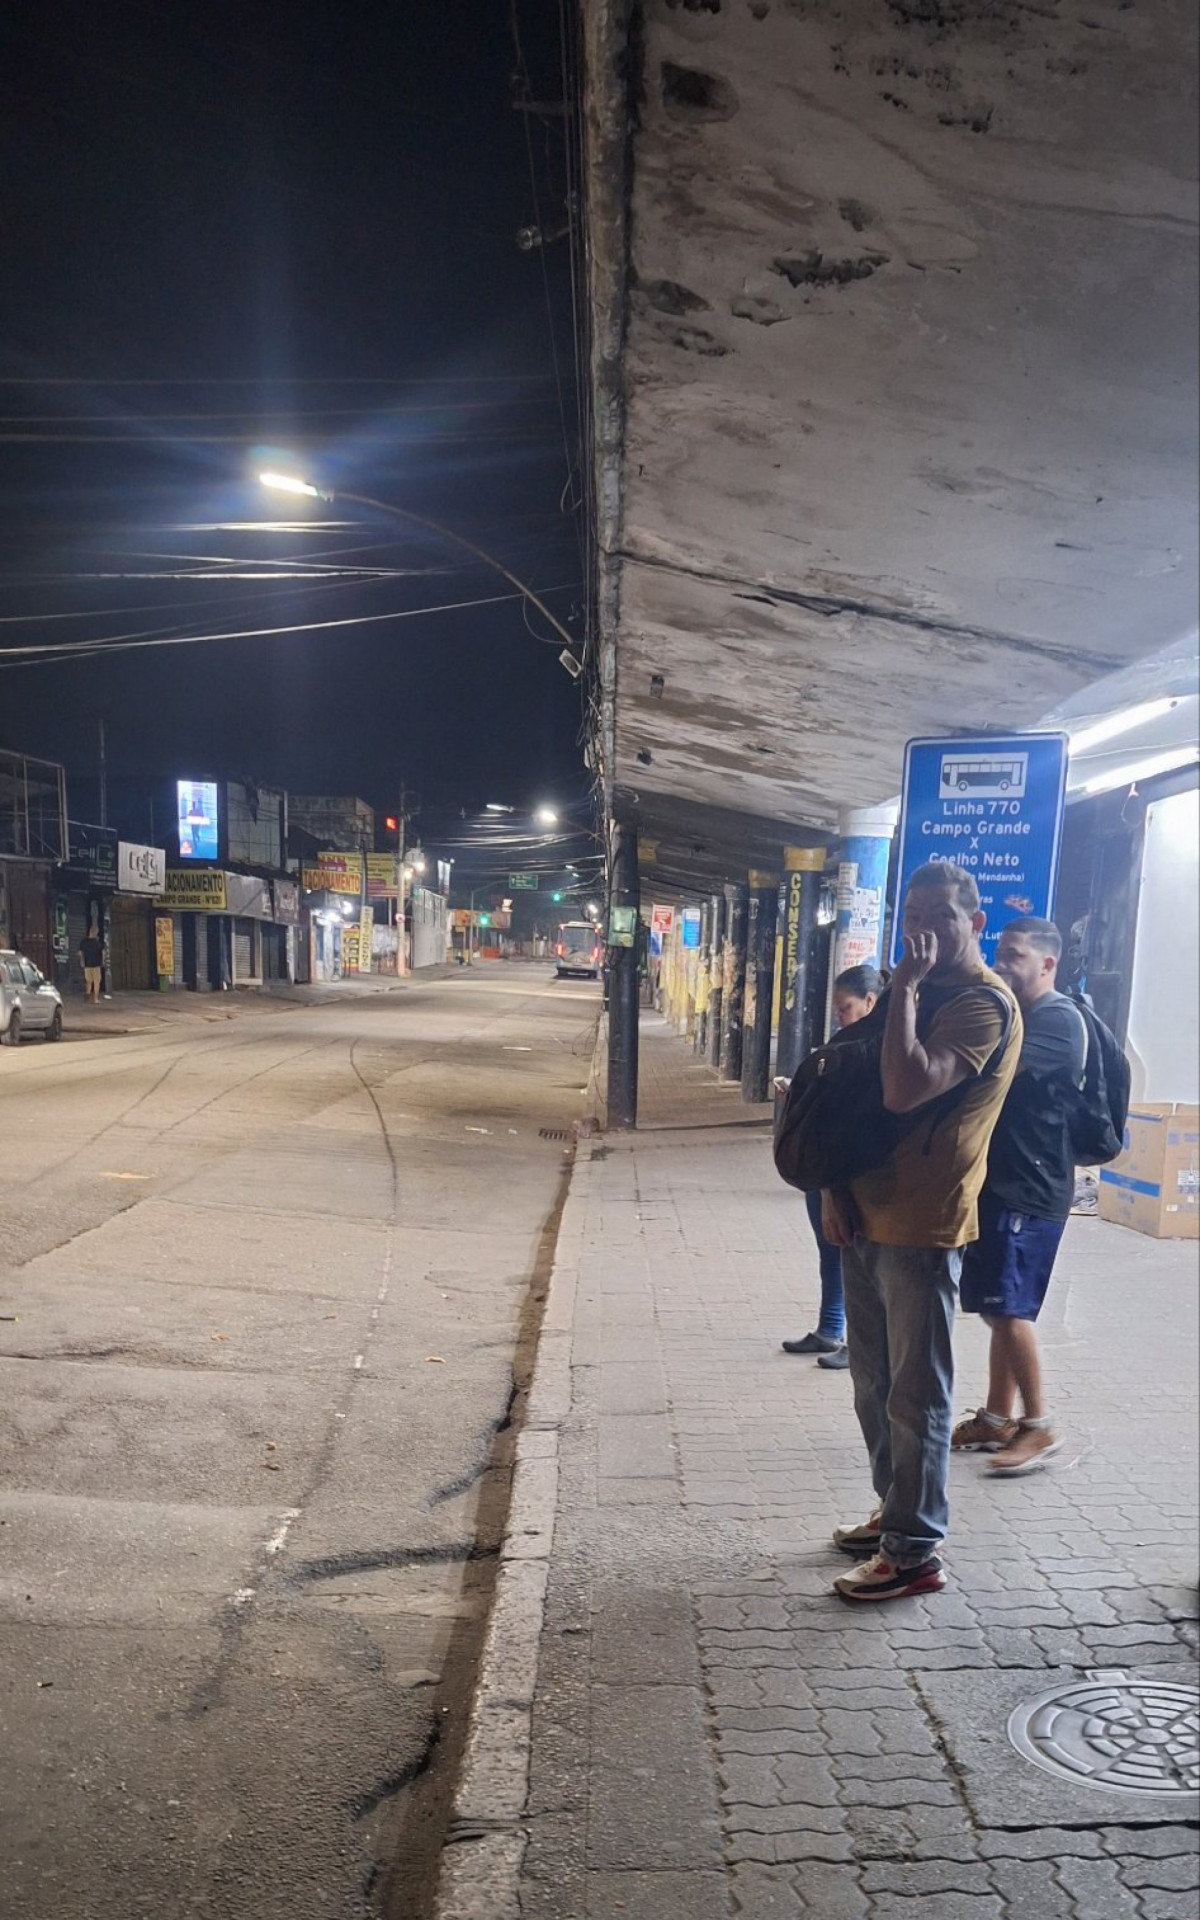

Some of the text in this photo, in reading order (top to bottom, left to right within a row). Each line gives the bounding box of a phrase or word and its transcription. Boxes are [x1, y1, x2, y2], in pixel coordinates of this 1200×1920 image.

[942, 801, 1021, 816] Linha 770
[921, 820, 1031, 838] Campo Grande
[929, 851, 1020, 866] Coelho Neto
[977, 872, 1025, 884] Mendanha)
[177, 894, 201, 905] GRANDE
[785, 872, 802, 1011] CONSERTO
